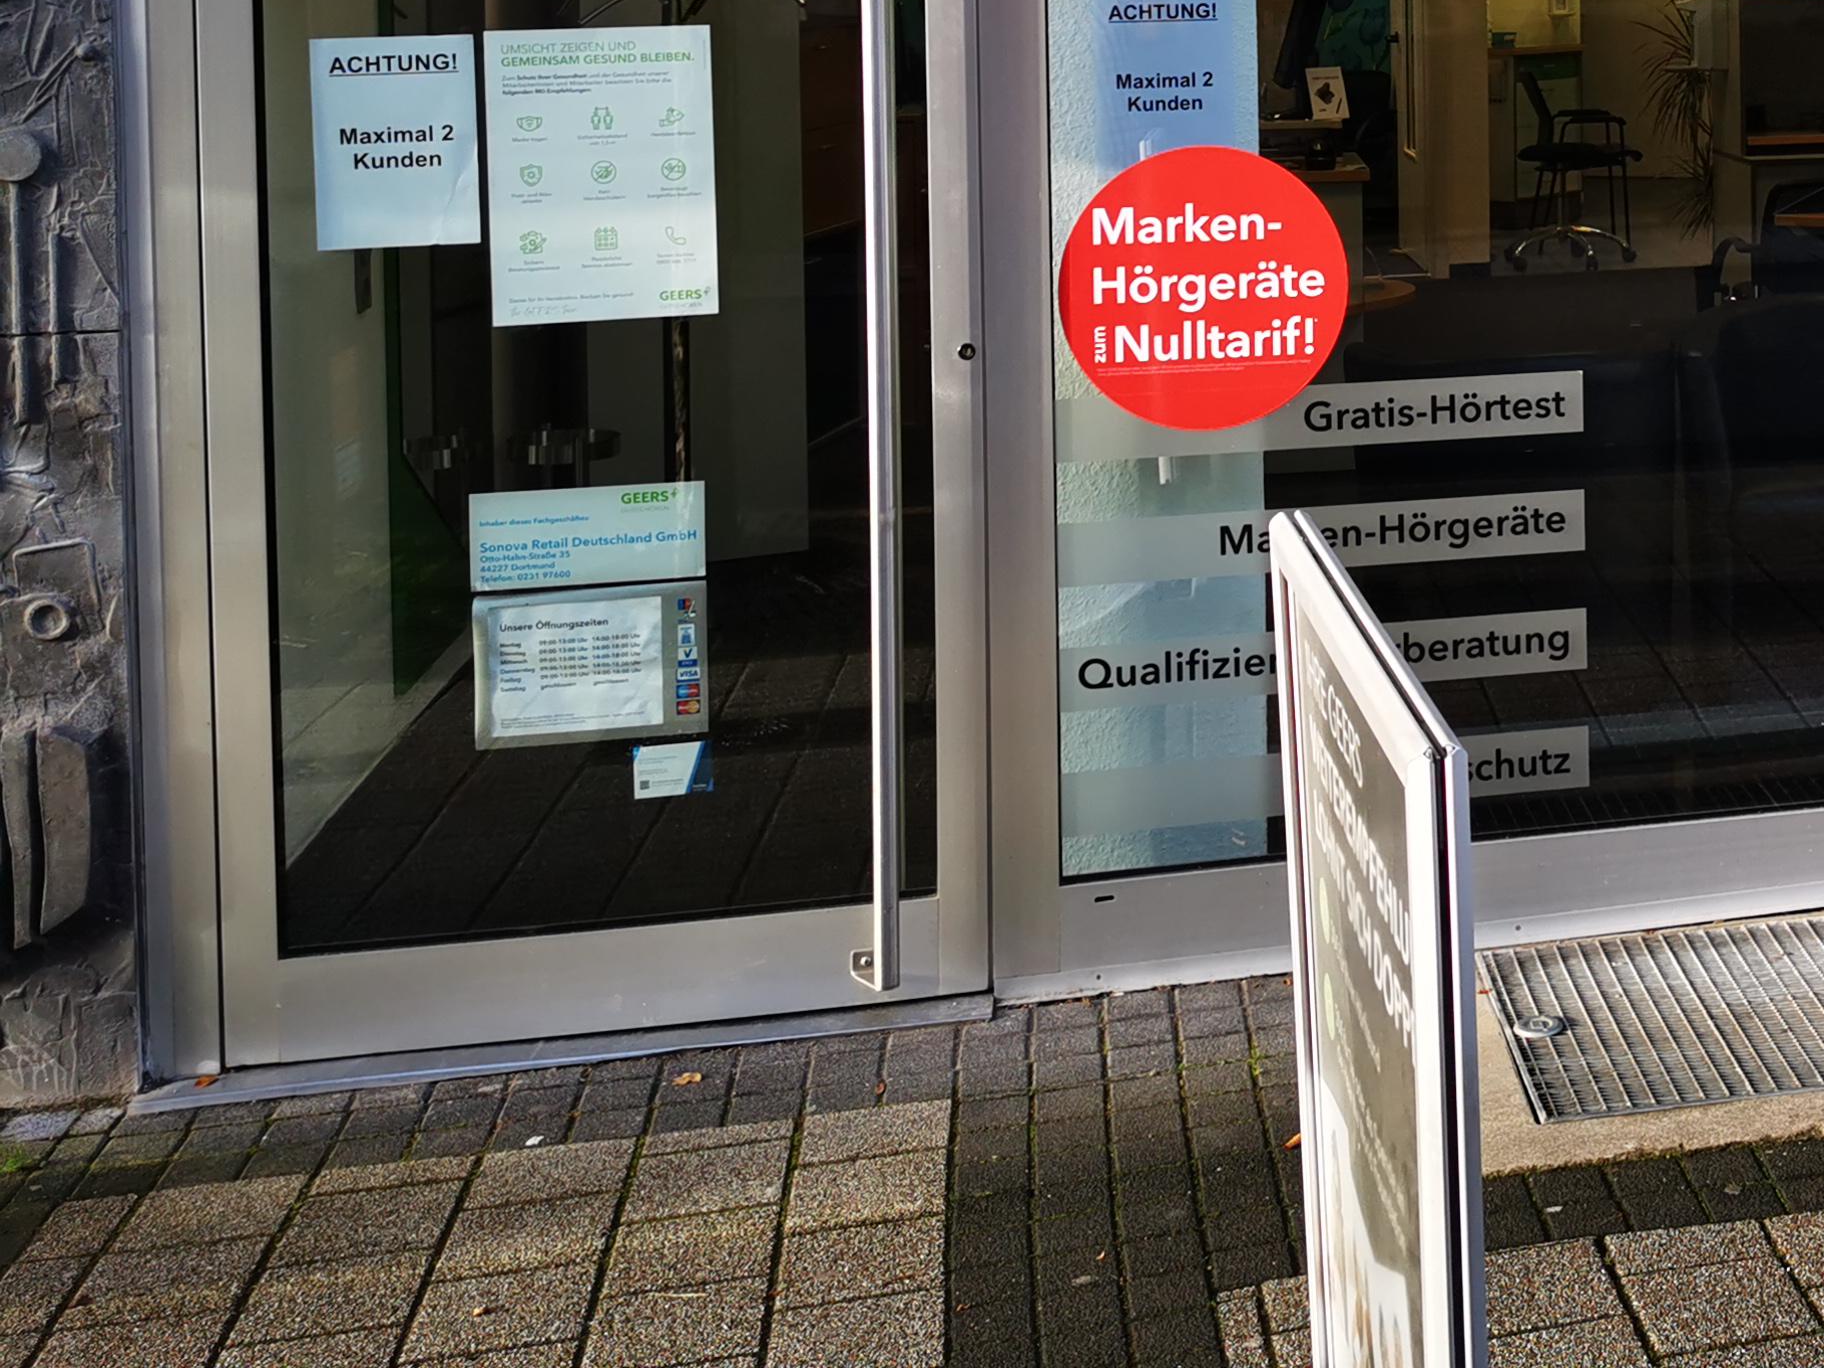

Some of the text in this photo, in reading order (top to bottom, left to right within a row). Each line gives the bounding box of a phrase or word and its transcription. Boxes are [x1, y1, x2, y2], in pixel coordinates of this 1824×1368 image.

[1109, 3, 1217, 21] ACHTUNG!
[501, 40, 636, 54] UMSICHT ZEIGEN UND
[329, 53, 458, 75] ACHTUNG!
[501, 52, 695, 67] GEMEINSAM GESUND BLEIBEN.
[1116, 72, 1214, 90] Maximal 2
[1127, 95, 1203, 112] Kunden
[339, 125, 454, 146] Maximal 2
[353, 151, 442, 170] Kunden
[1092, 202, 1282, 246] Marken-
[659, 288, 702, 301] GEERS
[1092, 260, 1325, 313] Hörgeräte
[1094, 315, 1315, 364] zum Nulltarif!
[1304, 392, 1566, 433] Gratis-Hörtest
[621, 490, 669, 504] GEERS
[1219, 506, 1567, 556] Maen-Hörgeräte
[480, 530, 697, 553] Sonova Retail Deutschland GmbH
[511, 562, 556, 571] Dortmund
[500, 618, 608, 632] Unsere Öffnungszeiten
[1397, 629, 1571, 664] beratung
[680, 670, 698, 678] VISA
